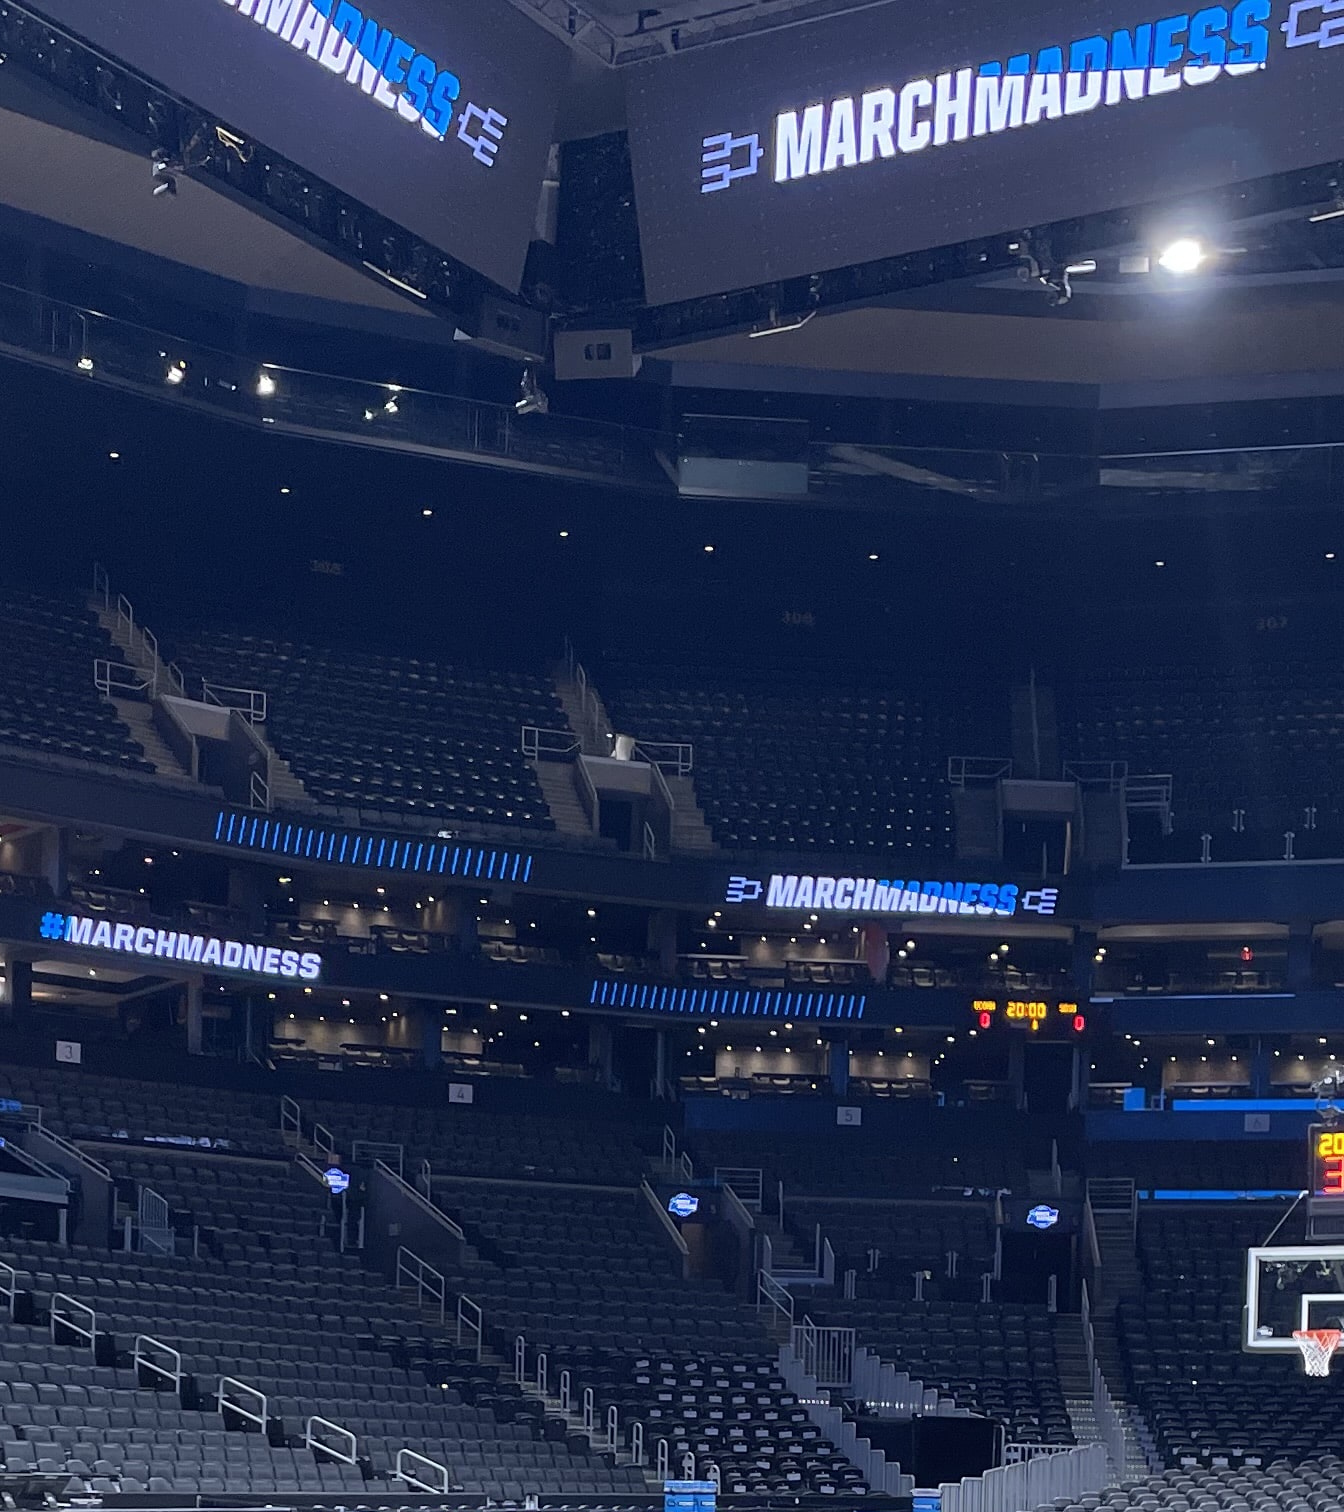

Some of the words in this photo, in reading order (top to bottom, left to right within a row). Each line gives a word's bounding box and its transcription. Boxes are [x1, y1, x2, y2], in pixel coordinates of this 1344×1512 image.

[775, 0, 1270, 183] MARCHMADNESS
[766, 874, 1019, 915] MARCHMADNESS
[41, 912, 321, 979] #MARCHMADNESS
[1006, 1001, 1047, 1019] 20:00
[64, 1045, 73, 1060] 3
[456, 1086, 466, 1101] 4
[844, 1108, 852, 1122] 5
